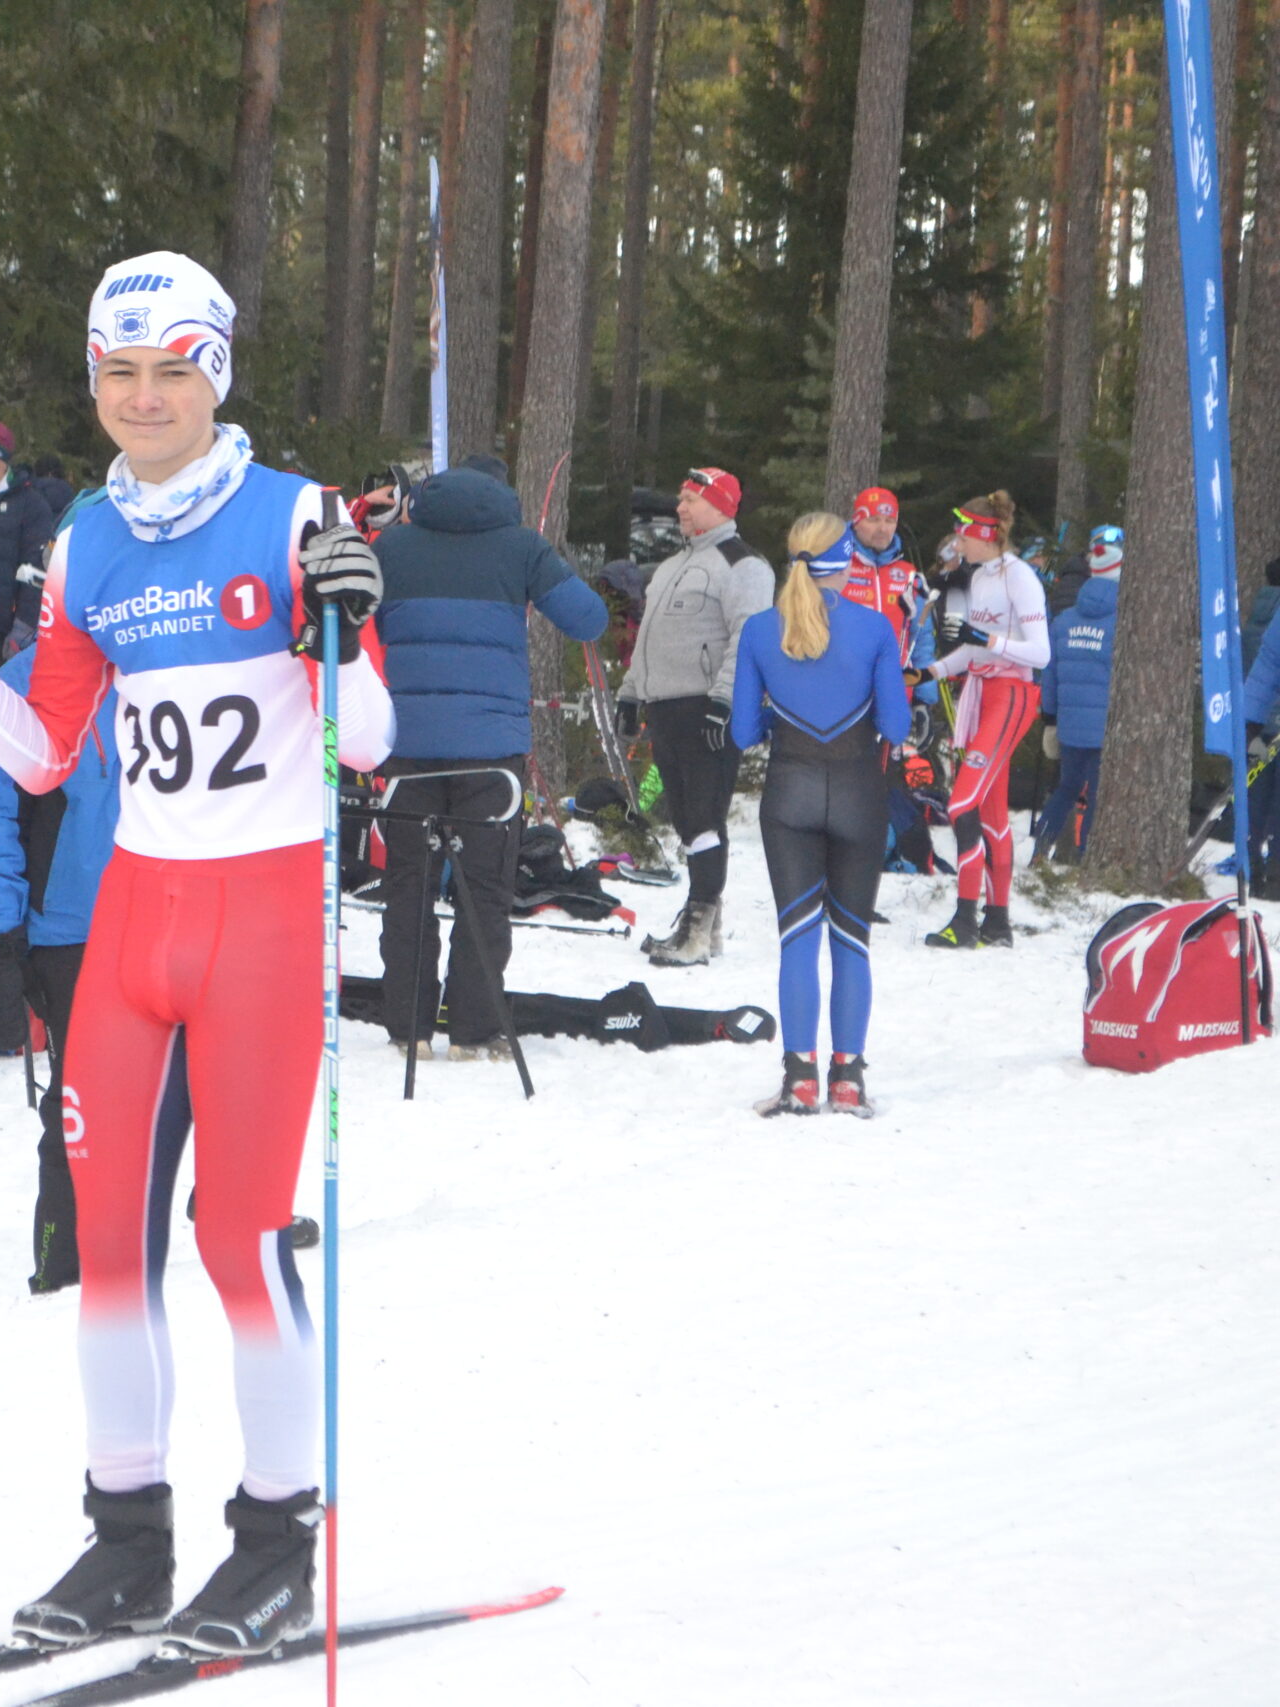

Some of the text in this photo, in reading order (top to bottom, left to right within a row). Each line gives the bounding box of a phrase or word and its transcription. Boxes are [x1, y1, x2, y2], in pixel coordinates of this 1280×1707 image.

[86, 580, 214, 632] SpareBank
[970, 607, 1004, 625] wix
[115, 615, 216, 645] ØSTLANDET
[1068, 625, 1105, 641] HAMAR
[604, 1012, 642, 1030] swix
[1178, 1020, 1240, 1042] MADSHUS
[243, 1588, 293, 1630] salomon
